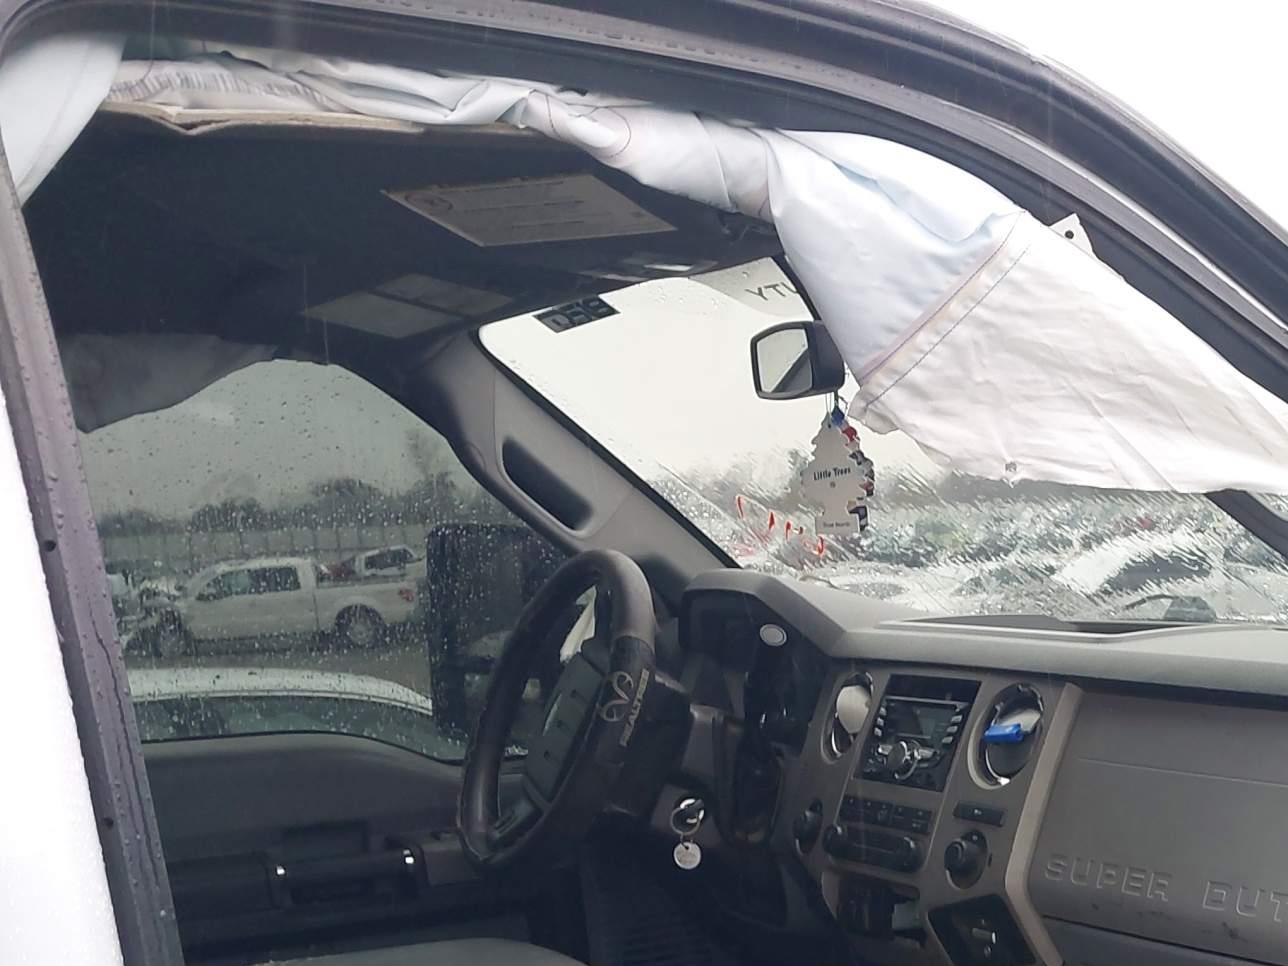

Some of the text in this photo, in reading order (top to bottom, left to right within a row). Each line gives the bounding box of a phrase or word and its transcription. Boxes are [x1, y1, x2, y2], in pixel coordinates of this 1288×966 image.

[813, 467, 851, 481] Little Trees
[1044, 852, 1174, 903] SUPER
